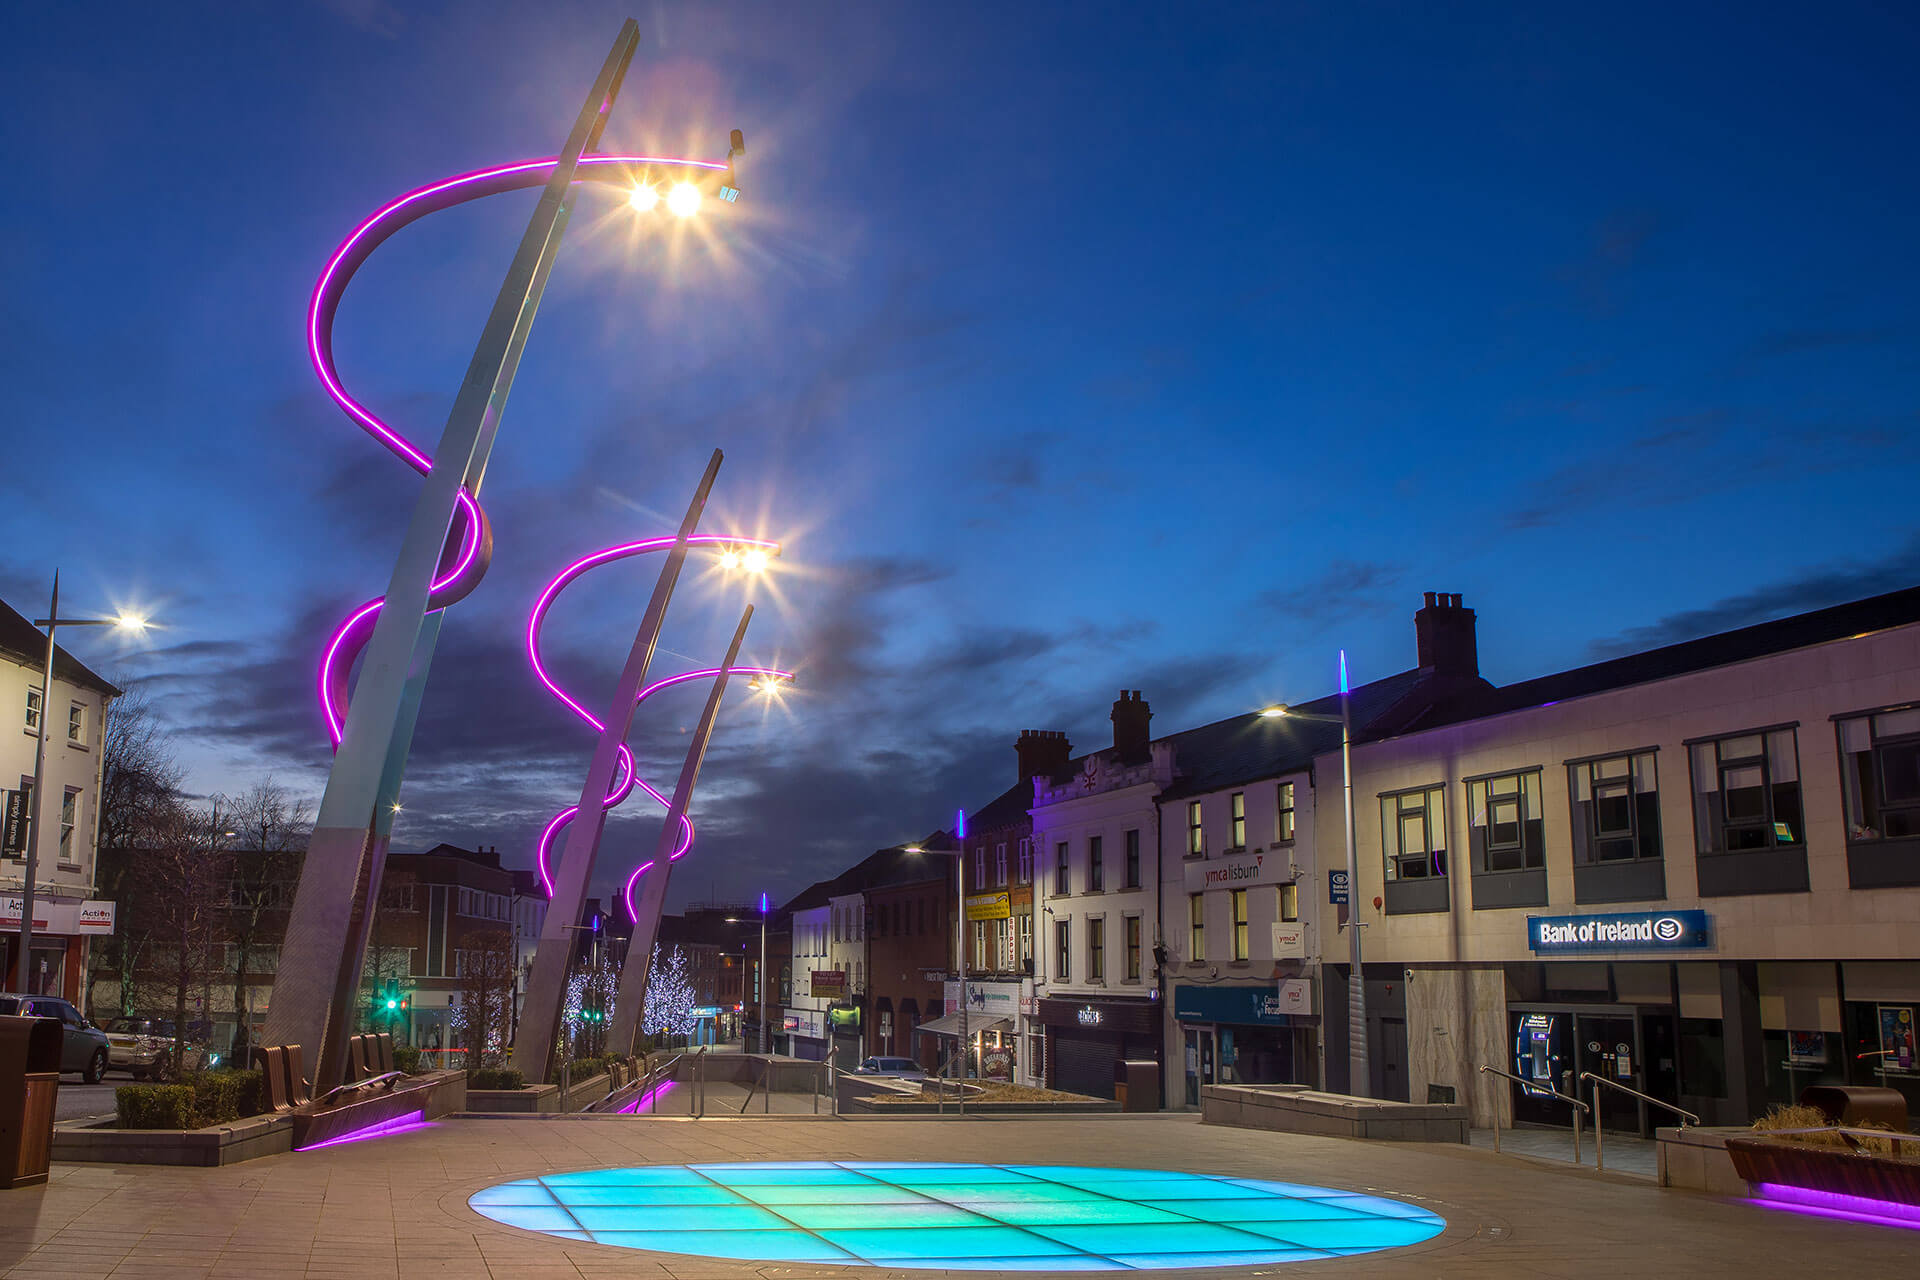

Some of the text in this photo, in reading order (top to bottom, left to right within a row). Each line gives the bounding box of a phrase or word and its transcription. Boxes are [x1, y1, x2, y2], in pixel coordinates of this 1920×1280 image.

[1540, 920, 1652, 942] Bank of Ireland
